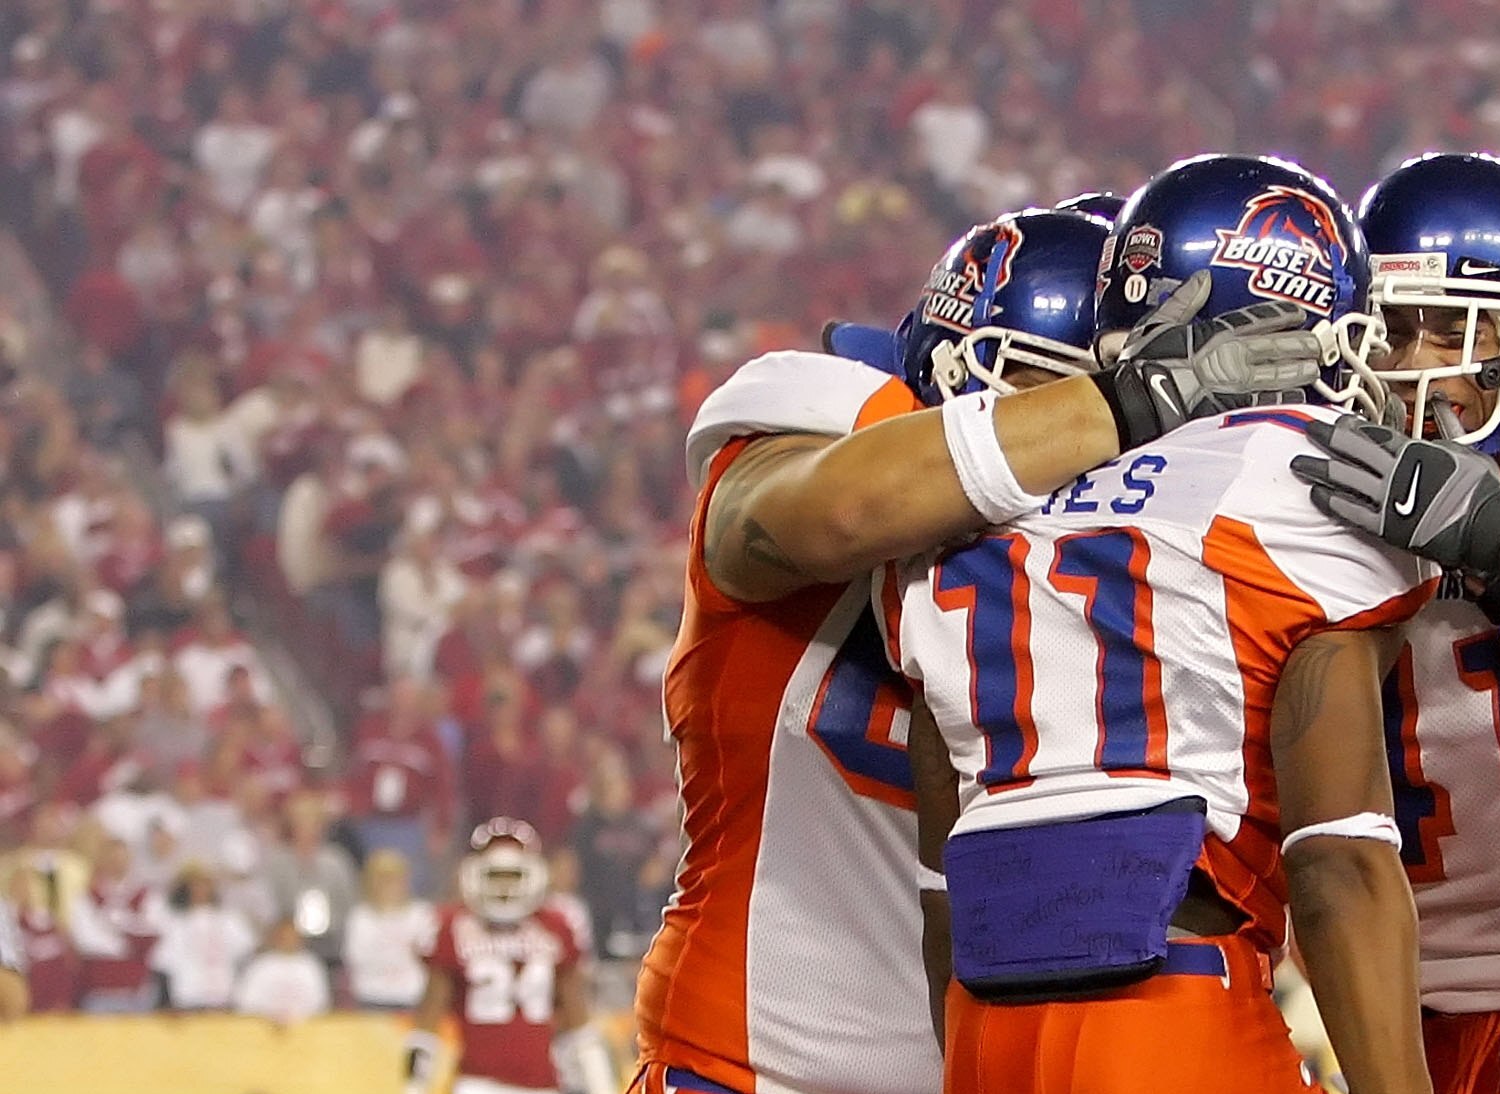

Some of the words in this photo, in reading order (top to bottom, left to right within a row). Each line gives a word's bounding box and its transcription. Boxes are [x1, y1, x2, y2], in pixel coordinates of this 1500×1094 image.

[1223, 237, 1309, 274] BOISE
[1256, 267, 1335, 307] STATE
[933, 526, 1171, 795] 11
